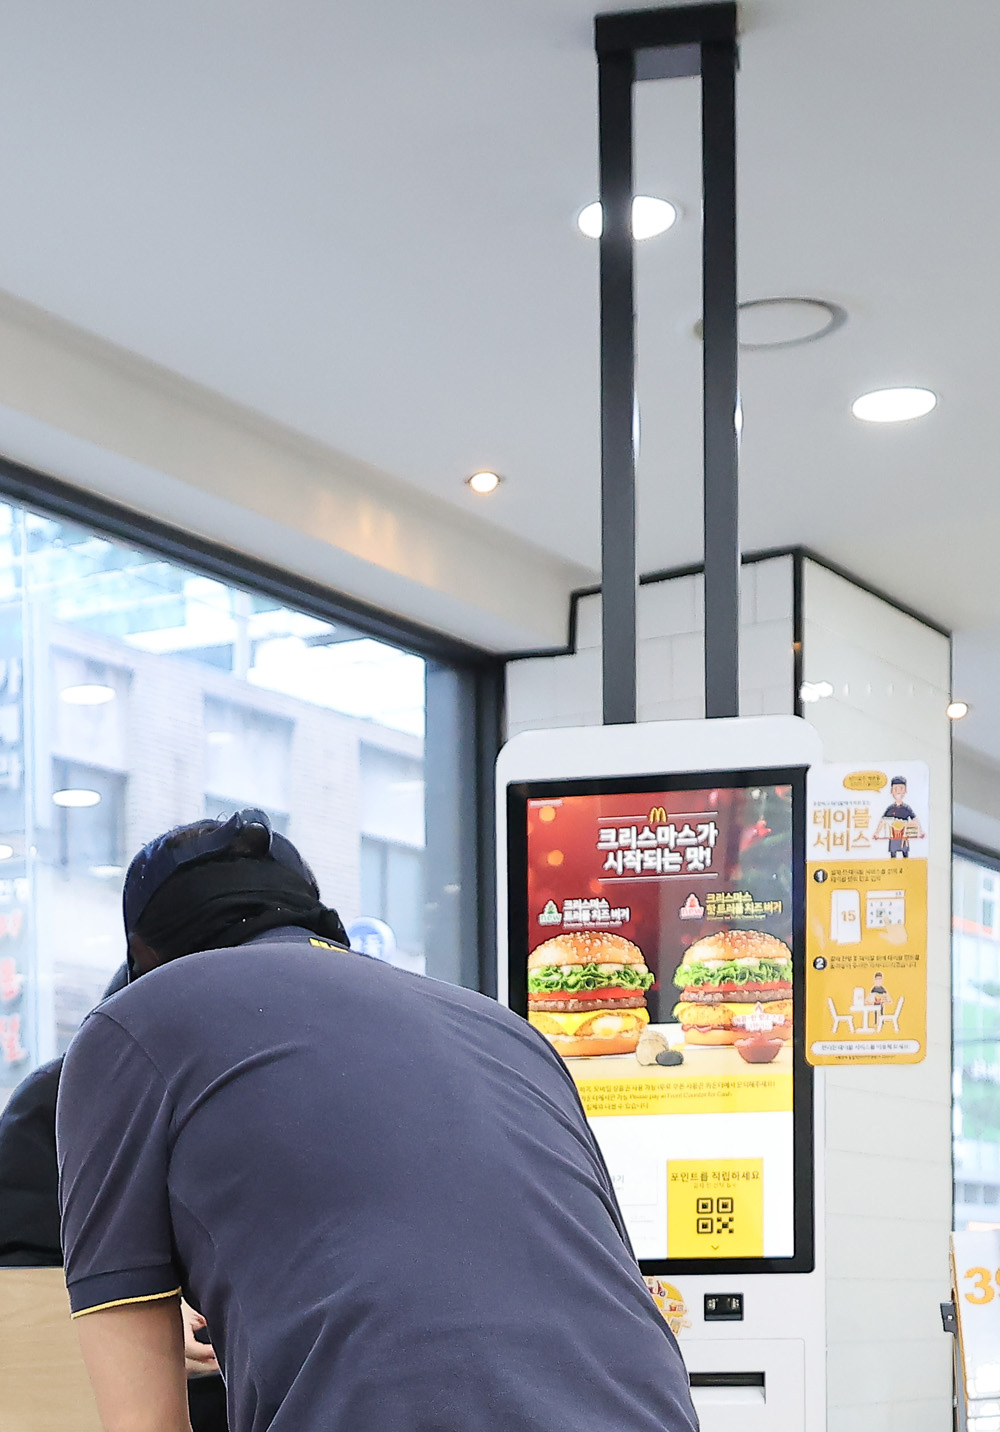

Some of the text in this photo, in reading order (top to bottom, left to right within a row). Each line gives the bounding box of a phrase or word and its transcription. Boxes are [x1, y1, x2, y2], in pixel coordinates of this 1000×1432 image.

[813, 807, 871, 829] 테이블
[596, 821, 719, 850] 크리스마스가
[813, 830, 871, 852] 서비스
[603, 845, 712, 875] 시작되는 맛!
[563, 898, 609, 911] 크리스마스
[706, 891, 753, 903] 크리스마스
[841, 909, 856, 922] 15
[815, 957, 825, 970] 2
[670, 1170, 760, 1183] 포인트를 적립하세요
[964, 1267, 1000, 1305] 3
